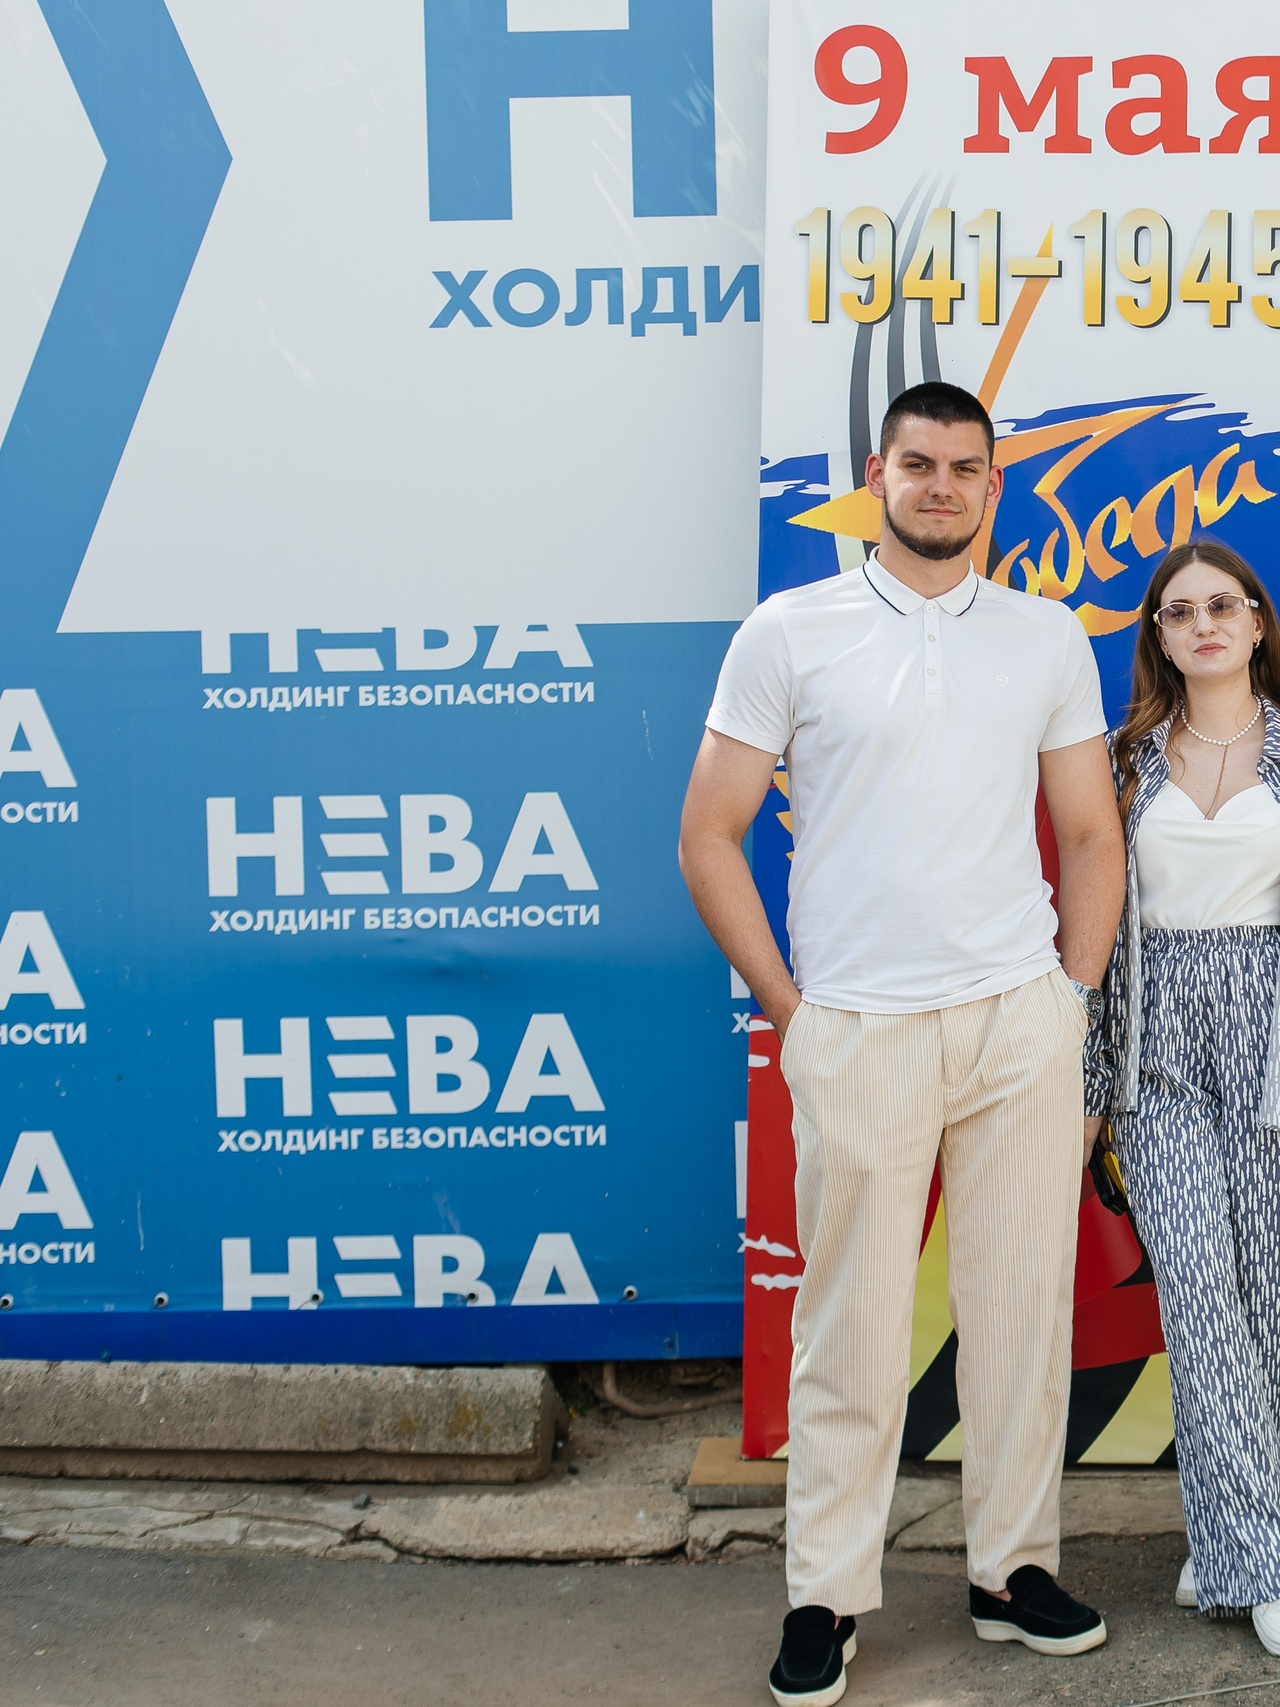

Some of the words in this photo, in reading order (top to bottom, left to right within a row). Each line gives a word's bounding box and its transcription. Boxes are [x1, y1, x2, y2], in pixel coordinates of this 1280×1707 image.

[814, 24, 908, 154] 9
[429, 264, 761, 338] ХОЛДИ
[202, 686, 350, 712] ХОЛДИНГ
[358, 682, 595, 707] БЕЗОПАСНОСТИ
[206, 791, 599, 897] НЕВА
[209, 909, 355, 934] ХОЛДИНГ
[364, 904, 600, 930] БЕЗОПАСНОСТИ
[213, 1013, 606, 1118] НЕВА
[218, 1129, 364, 1155] ХОЛДИНГ
[372, 1125, 607, 1150] БЕЗОПАСНОСТИ
